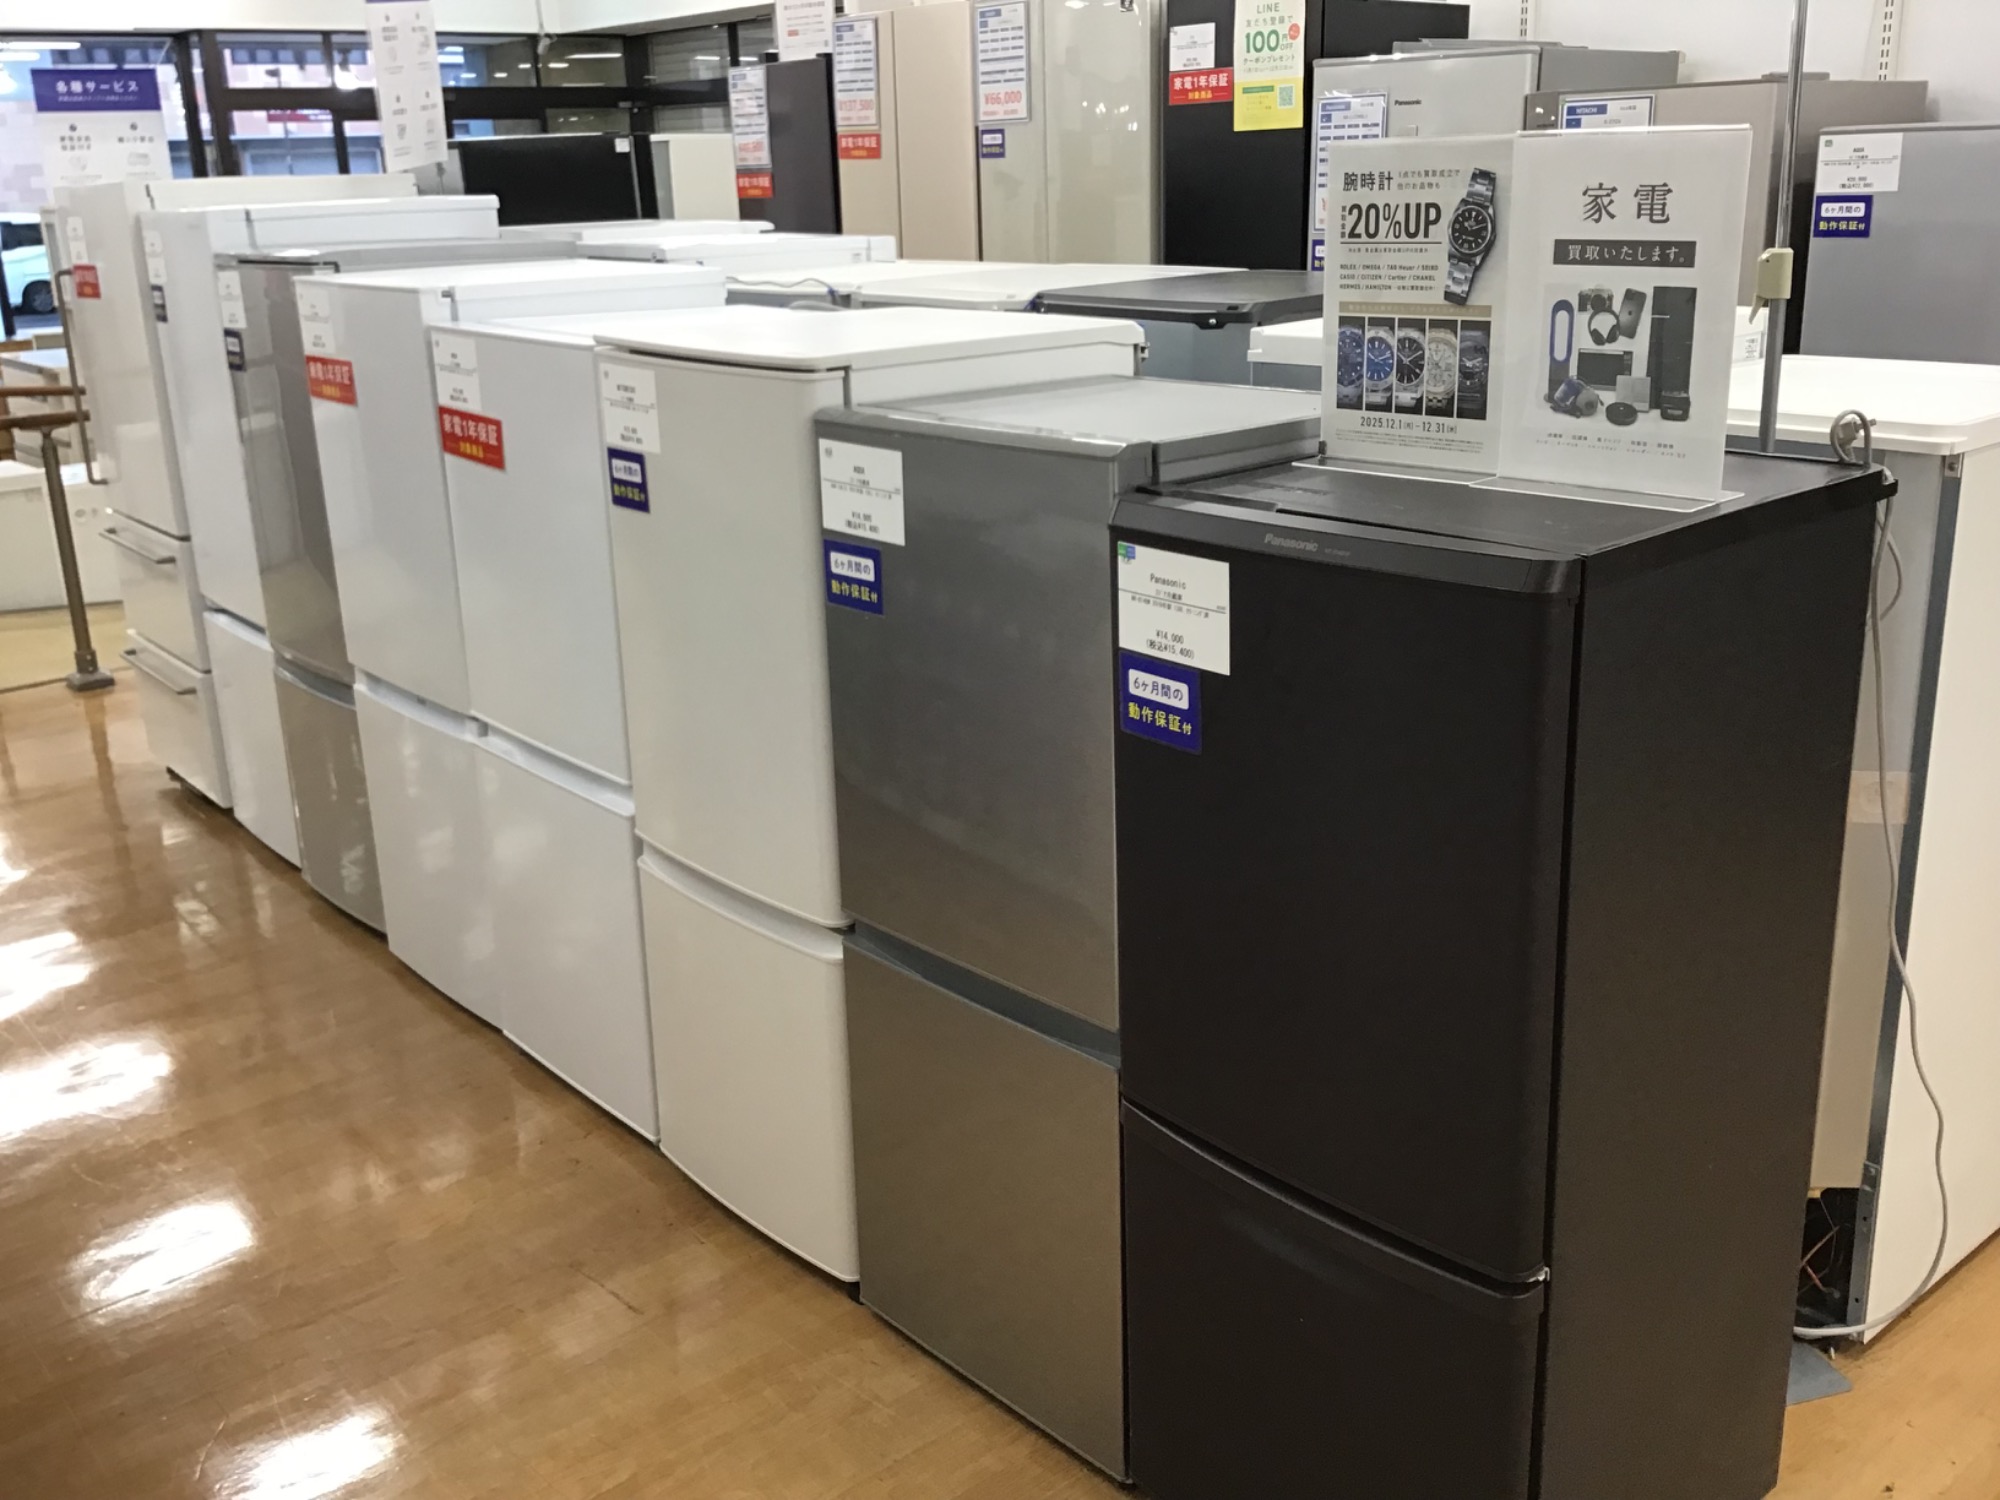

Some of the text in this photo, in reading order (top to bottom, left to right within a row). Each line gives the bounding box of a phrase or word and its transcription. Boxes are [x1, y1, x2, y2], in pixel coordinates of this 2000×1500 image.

[1257, 3, 1280, 14] LINE
[1245, 29, 1280, 53] 100
[56, 80, 139, 94] 各種サービス
[1173, 73, 1229, 91] 家電1年保証
[983, 90, 1022, 106] ¥66,000
[1343, 171, 1394, 192] 腕時計
[1582, 182, 1674, 224] 家電
[1348, 202, 1442, 240] 20%UP
[1568, 244, 1685, 263] 買取いたします。
[442, 413, 499, 446] 家電1年保証
[1264, 533, 1319, 552] Panasonic
[1149, 572, 1187, 590] Panasonic
[1127, 701, 1192, 736] 動作保証付
